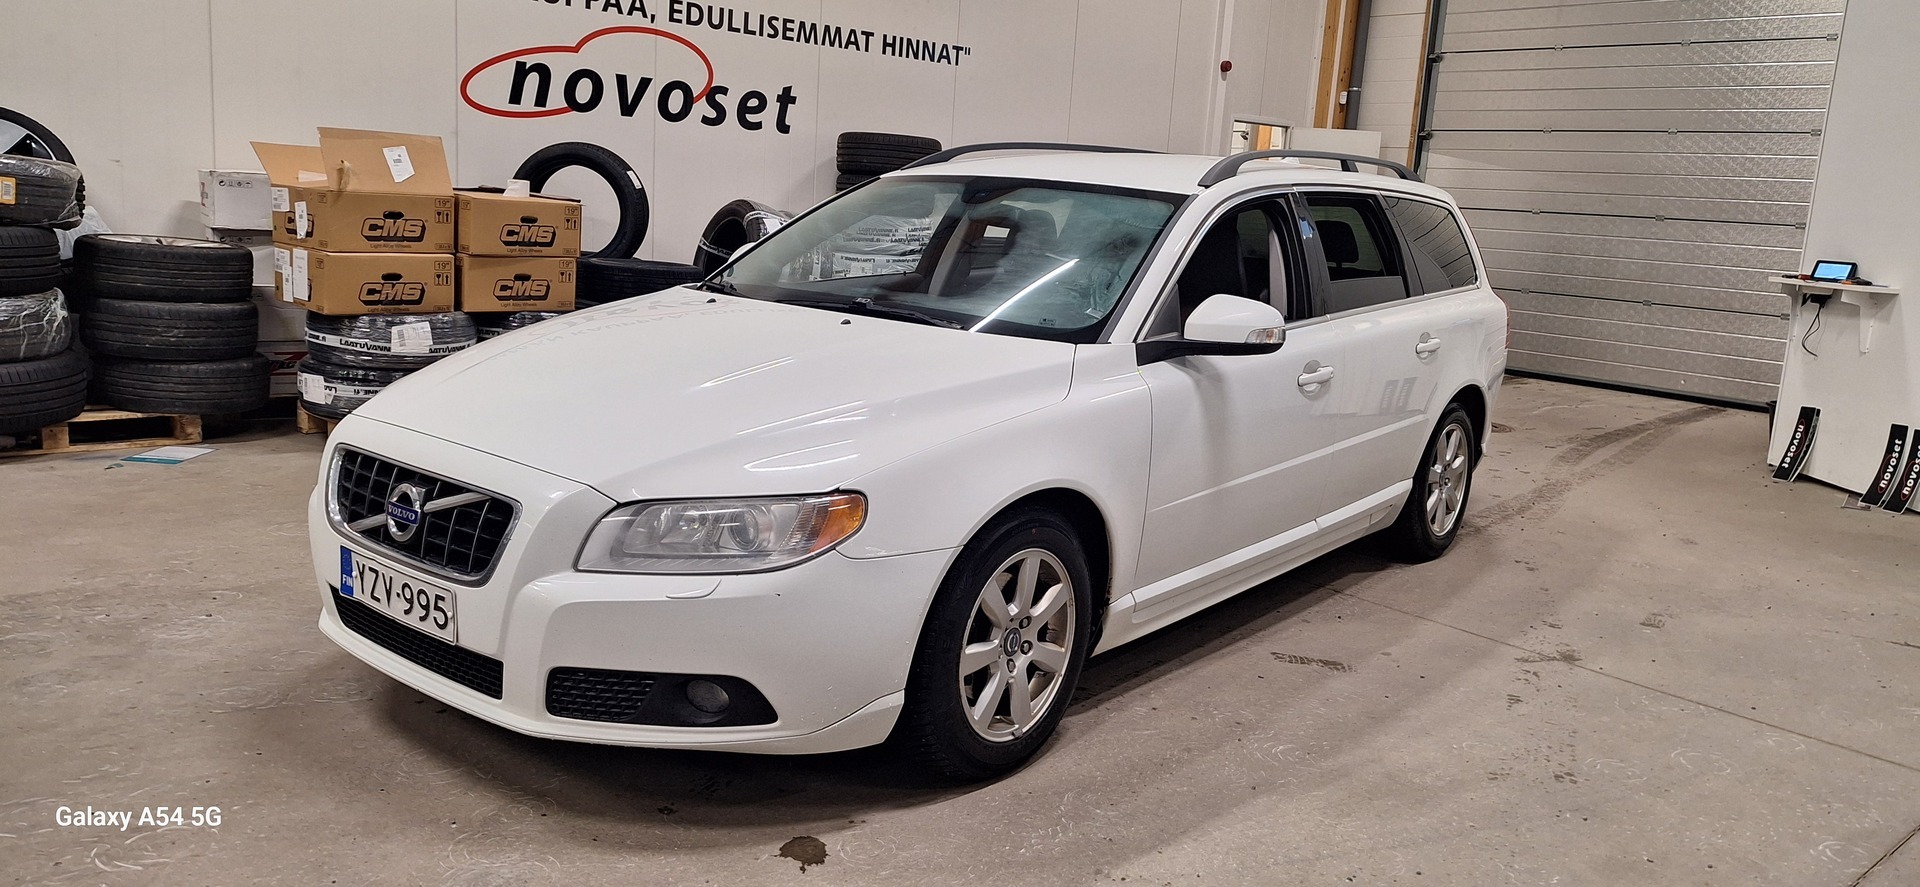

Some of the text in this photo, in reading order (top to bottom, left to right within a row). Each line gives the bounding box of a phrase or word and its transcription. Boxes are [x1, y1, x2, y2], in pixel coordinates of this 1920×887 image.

[668, 0, 875, 53] EDULLISEMMAT
[882, 33, 971, 66] HINNAT"
[508, 60, 797, 135] novoset
[361, 218, 426, 243] CMS
[500, 224, 557, 247] CMS
[358, 282, 426, 306] CMS
[493, 279, 551, 301] CMS
[339, 338, 391, 353] LAATUVANN
[1782, 424, 1805, 469] novoset
[1879, 438, 1903, 488] novoset
[388, 504, 416, 521] VOLVO
[342, 559, 449, 630] FIN YZV-995
